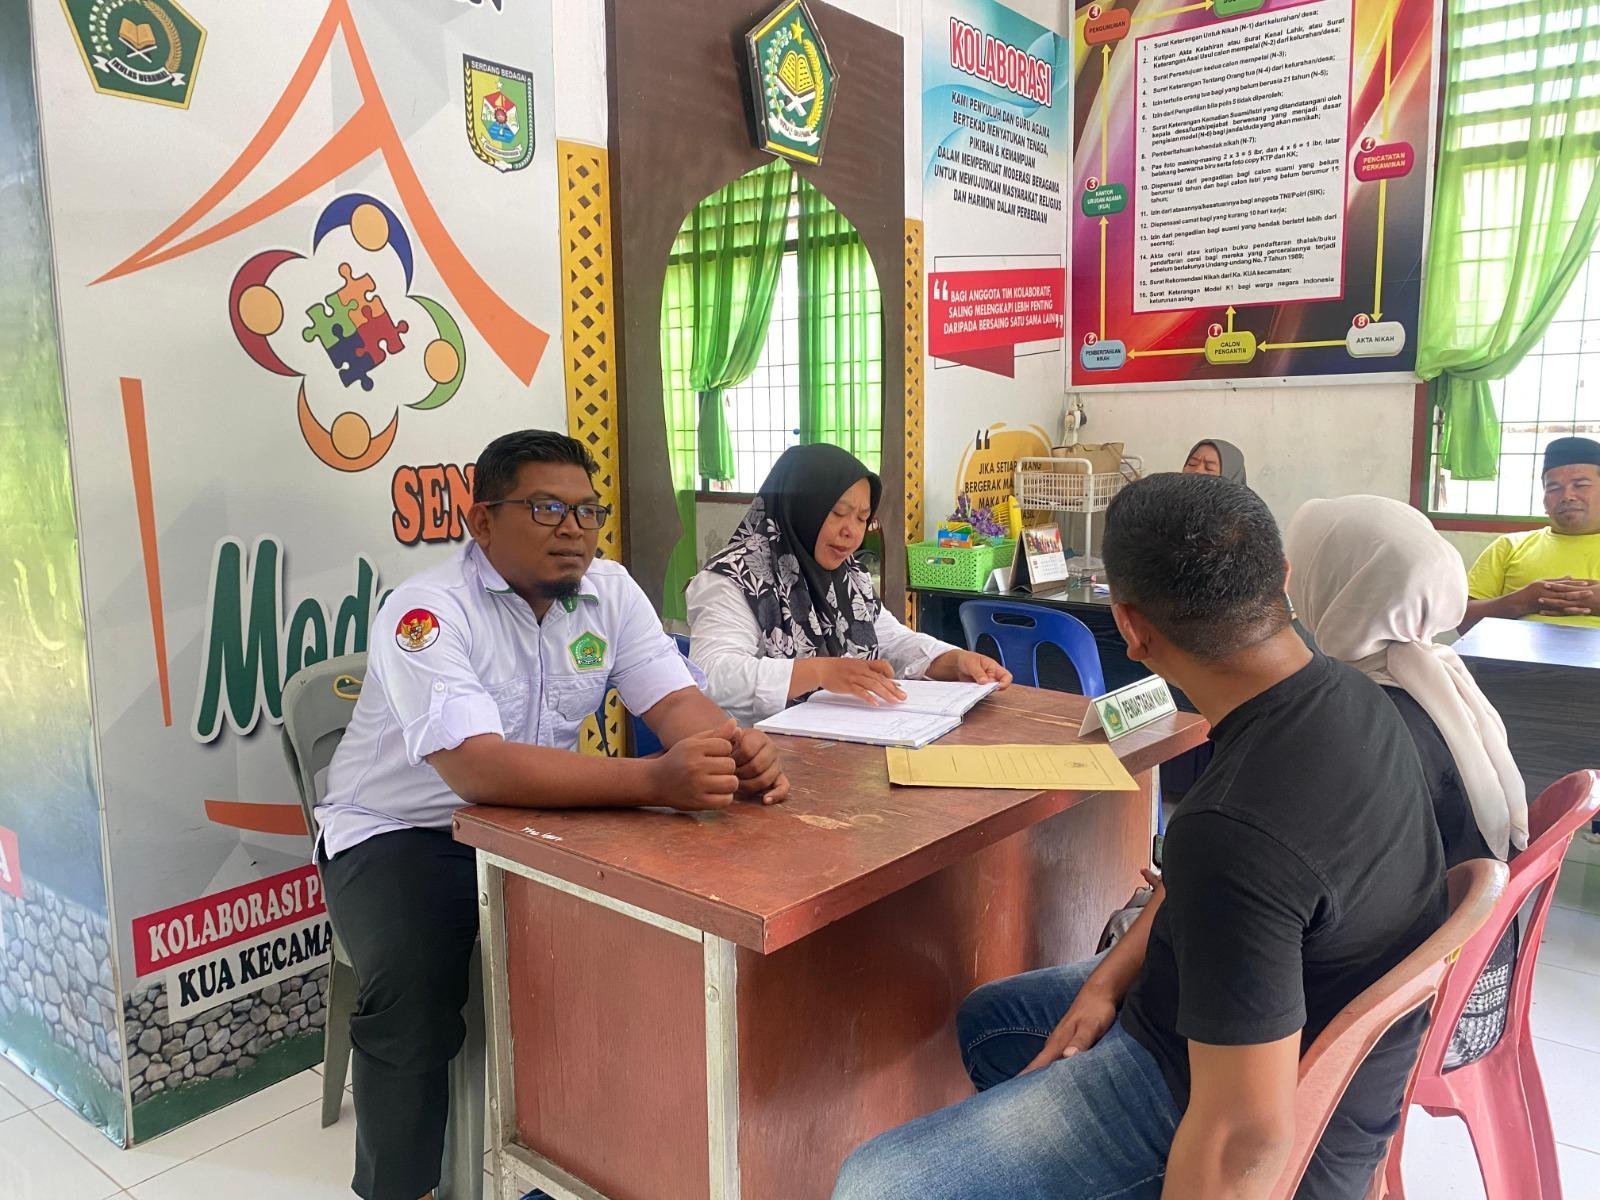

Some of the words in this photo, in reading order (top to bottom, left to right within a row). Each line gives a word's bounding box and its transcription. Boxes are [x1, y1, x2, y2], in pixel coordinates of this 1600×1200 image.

[1153, 52, 1175, 62] Kutipan
[1195, 42, 1223, 52] Kelahiran
[1244, 34, 1260, 42] Surat
[1264, 29, 1282, 38] Kenal
[1326, 17, 1344, 26] Surat
[1154, 40, 1169, 48] Surat
[1170, 33, 1202, 46] Keterangan
[1203, 30, 1220, 38] Untuk
[1221, 26, 1238, 34] Nikah
[1239, 22, 1253, 31] (N-1)
[1255, 19, 1266, 27] dari
[471, 60, 500, 75] SERDANG
[501, 68, 526, 83] BEDAGAI
[950, 17, 1051, 108] KOLABORASI
[1153, 85, 1168, 93] Surat
[1169, 79, 1201, 91] Keterangan
[1202, 74, 1225, 85] Tentang
[1226, 71, 1244, 80] Orang
[1256, 66, 1270, 75] (N-4)
[1271, 63, 1283, 71] dari
[952, 91, 968, 108] KAMI
[969, 98, 1001, 120] PENYULUH
[1003, 111, 1015, 125] DAN
[1016, 116, 1031, 131] GURU
[1032, 122, 1050, 138] AGAMA
[953, 111, 985, 133] BERTEKAD
[987, 123, 1025, 147] MENYATUKAN
[969, 136, 994, 155] PIKIRAN
[995, 145, 1000, 156] &
[1001, 147, 1035, 168] KEMAMPUAN
[1362, 160, 1406, 171] PERKAWINAN
[1363, 152, 1405, 163] PENCATATAN
[937, 145, 960, 163] DALAM
[962, 152, 1002, 176] MEMPERKUAT
[1003, 165, 1030, 184] MODERASI
[1032, 175, 1059, 194] BERAGAMA
[1151, 168, 1176, 177] belakang
[1177, 164, 1203, 173] berwarna
[1151, 180, 1181, 190] Dispensasi
[1201, 172, 1233, 183] pengadilan
[1236, 170, 1249, 178] bagi
[1254, 167, 1271, 175] calon
[1275, 164, 1294, 172] suami
[1298, 162, 1314, 170] yang
[1319, 158, 1339, 166] belum
[934, 164, 957, 181] UNTUK
[959, 171, 1001, 194] MEWUJUDKAN
[1002, 183, 1038, 204] MASYARAKAT
[1039, 195, 1062, 211] RELIGIUS
[953, 188, 967, 203] DAN
[968, 192, 996, 211] HARMONI
[997, 200, 1016, 216] DALAM
[1017, 206, 1047, 224] PERBEDAAN
[1150, 219, 1180, 228] Dispensasi
[1227, 211, 1248, 219] kurang
[1164, 275, 1202, 283] Rekomendasi
[1168, 287, 1200, 295] Keterangan
[1277, 279, 1298, 287] negara
[1303, 276, 1334, 284] Indonesia
[948, 305, 973, 318] SALING
[975, 302, 1013, 316] MELENGKAPI
[1014, 301, 1030, 313] LEBIH
[1031, 300, 1053, 311] PENTING
[950, 290, 967, 303] BAGI
[969, 289, 1000, 301] ANGGOTA
[1002, 288, 1012, 299] TIM
[943, 321, 977, 335] DARIPADA
[979, 319, 1008, 331] BERSAING
[1010, 317, 1024, 328] SATU
[1026, 315, 1041, 326] SAMA
[979, 462, 994, 474] JIKA
[997, 460, 1017, 473] SETIAP
[965, 479, 1001, 493] BERGERAK
[1003, 477, 1014, 489] MA
[149, 880, 301, 962] KOLABORASI
[178, 958, 236, 1007] KUA
[238, 920, 333, 985] KECAMA
